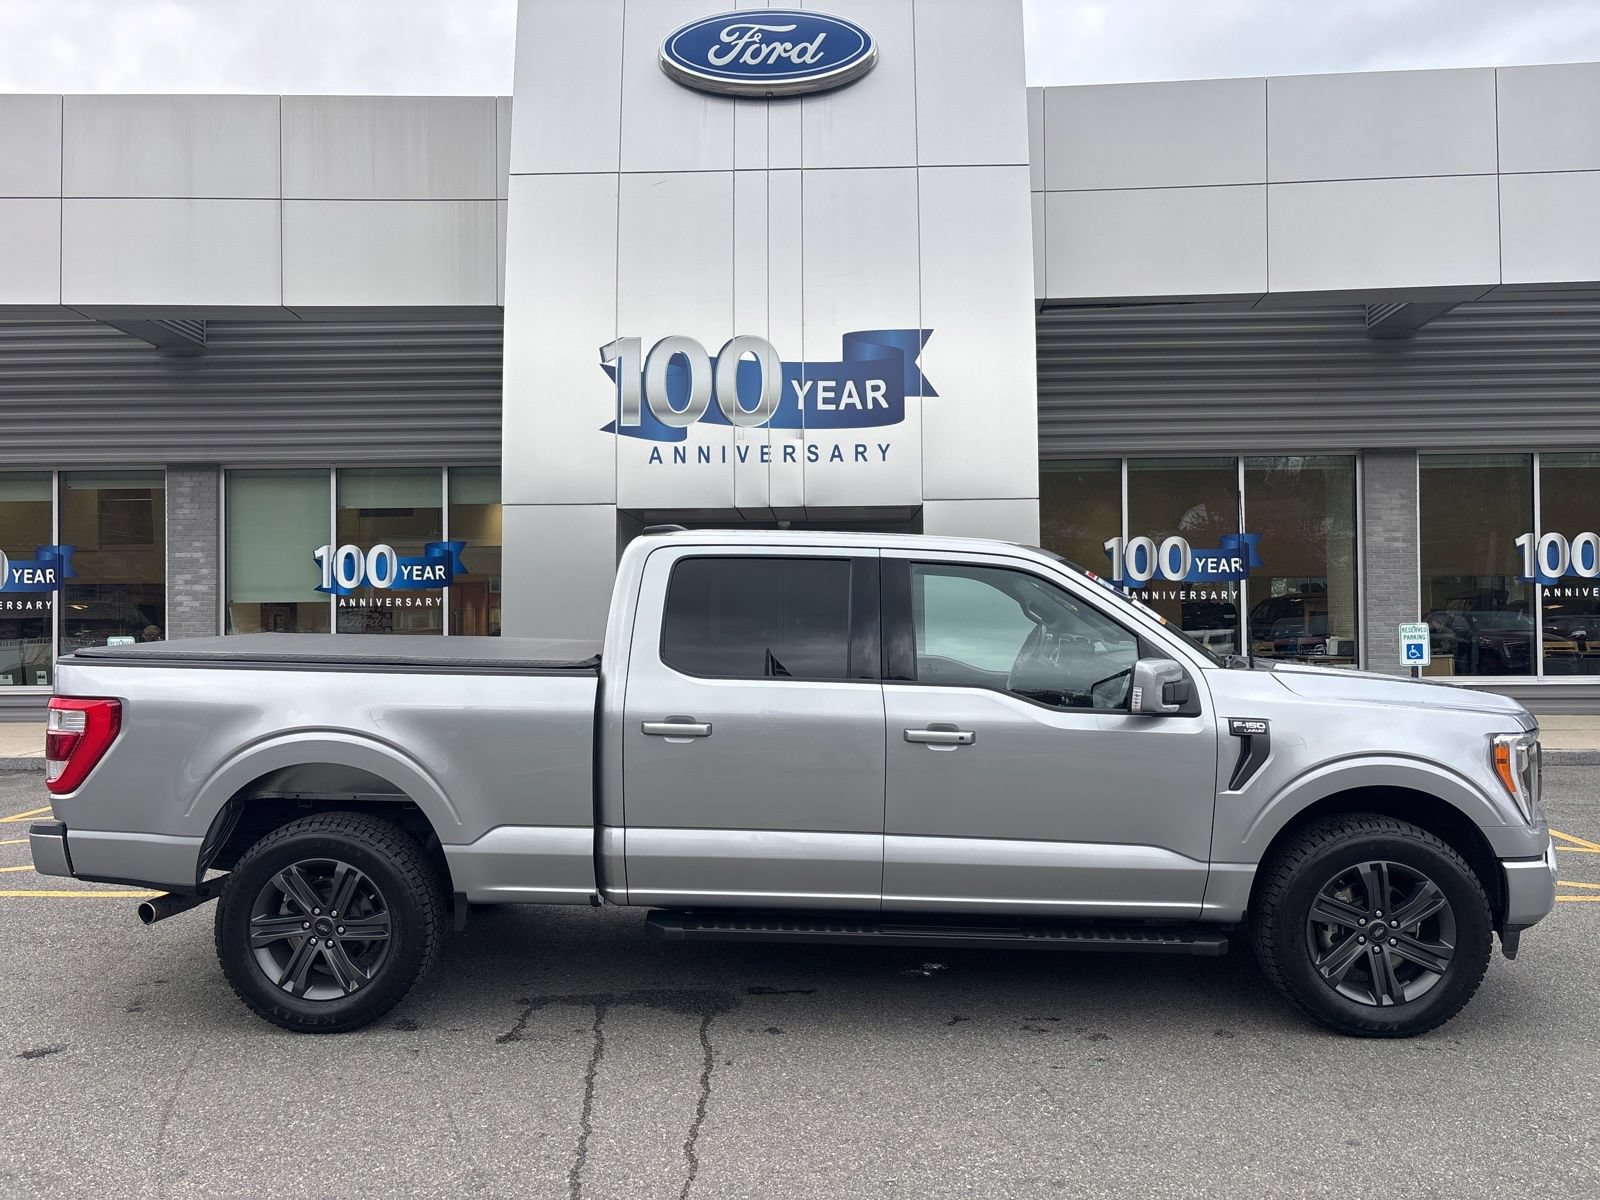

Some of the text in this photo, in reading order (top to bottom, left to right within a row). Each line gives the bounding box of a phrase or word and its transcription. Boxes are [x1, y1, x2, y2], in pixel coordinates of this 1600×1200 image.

[707, 23, 827, 66] Ford
[599, 335, 889, 428] 100 YEAR
[648, 443, 891, 464] ANNIVERSARY
[313, 543, 446, 589] 100 YEAR
[1103, 535, 1244, 581] 100 YEAR
[1514, 531, 1600, 578] 100
[12, 568, 56, 584] YEAR
[339, 597, 442, 607] ANNIVERSARY
[1131, 590, 1239, 600] ANNIVERSARY
[1233, 721, 1266, 729] F-150
